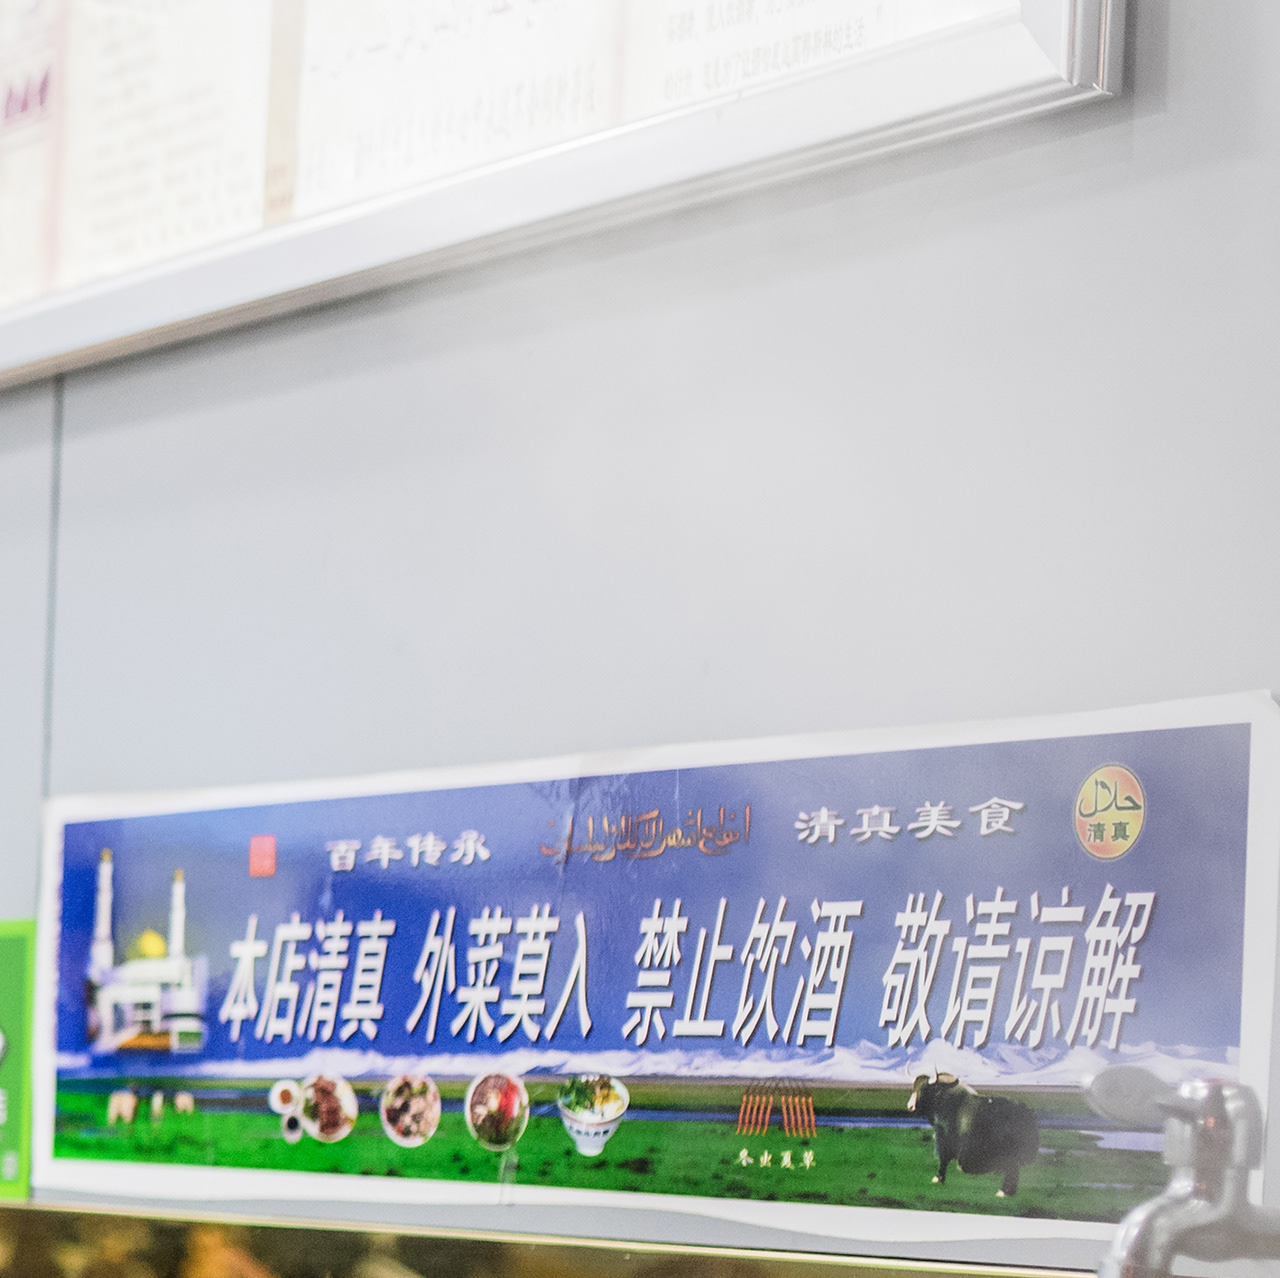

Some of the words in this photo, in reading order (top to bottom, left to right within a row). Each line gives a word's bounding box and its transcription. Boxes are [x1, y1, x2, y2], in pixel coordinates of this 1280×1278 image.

[794, 795, 1025, 845] 清真美食
[1087, 820, 1131, 843] 清真
[325, 828, 491, 872] 百年传承
[219, 909, 397, 1044] 本店清真
[404, 901, 594, 1044] 外菜莫入
[620, 895, 864, 1048] 禁止饮酒
[877, 880, 1157, 1050] 敬请谅解
